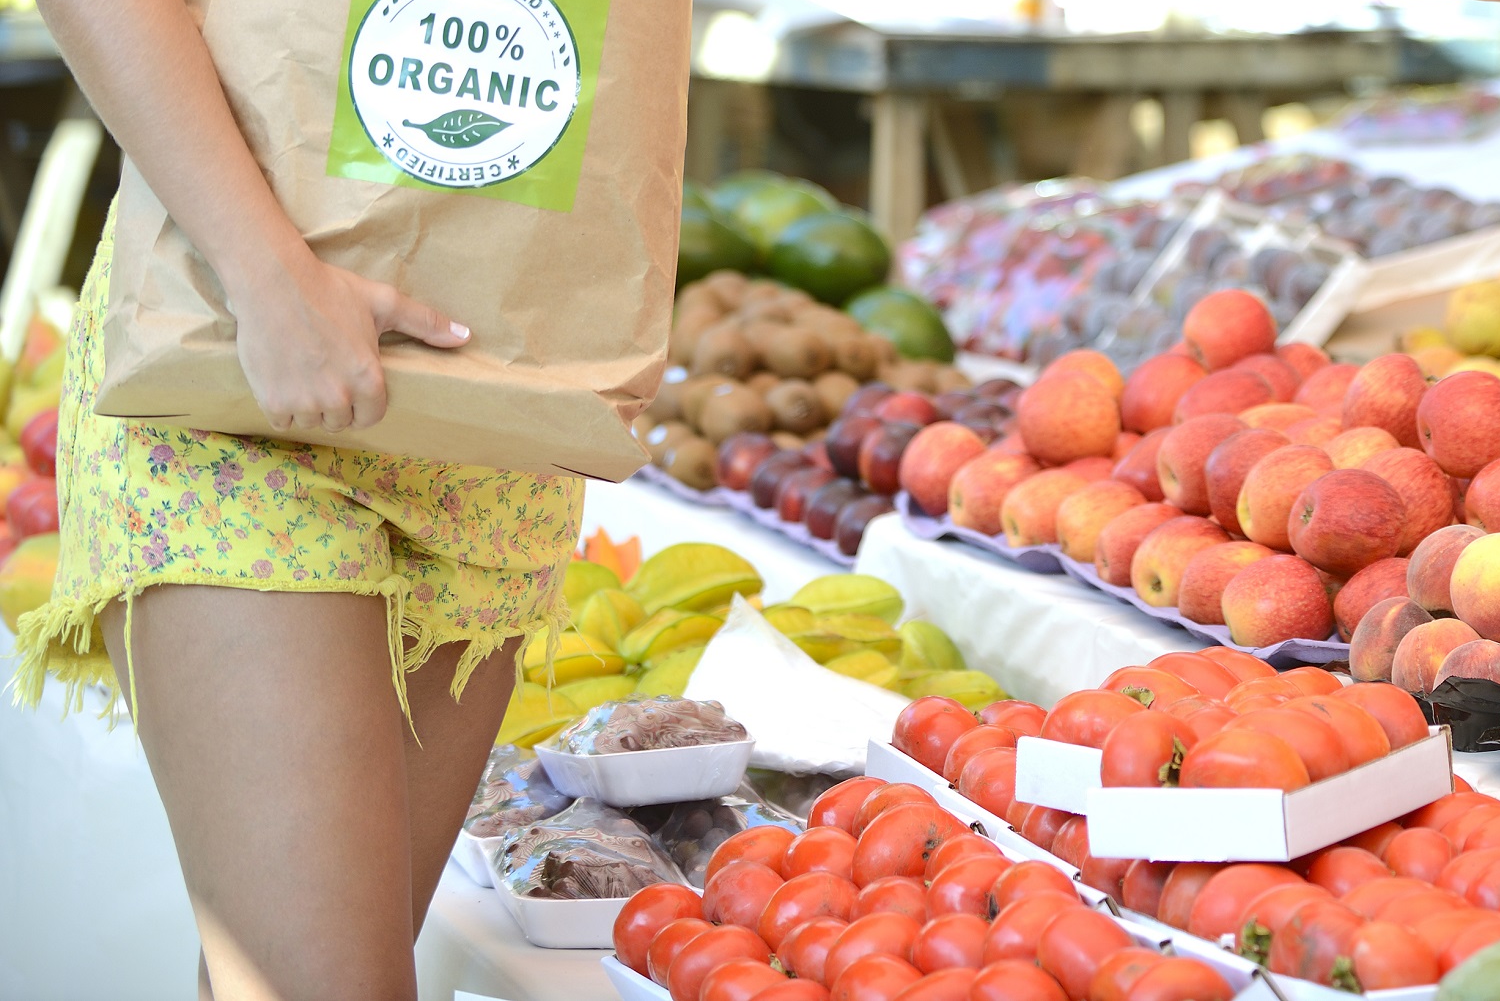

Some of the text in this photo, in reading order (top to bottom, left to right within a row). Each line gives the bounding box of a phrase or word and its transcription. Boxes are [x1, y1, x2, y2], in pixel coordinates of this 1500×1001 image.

[419, 12, 524, 60] 100%
[368, 53, 560, 112] ORGANIC
[395, 146, 502, 181] CERTIFIED
